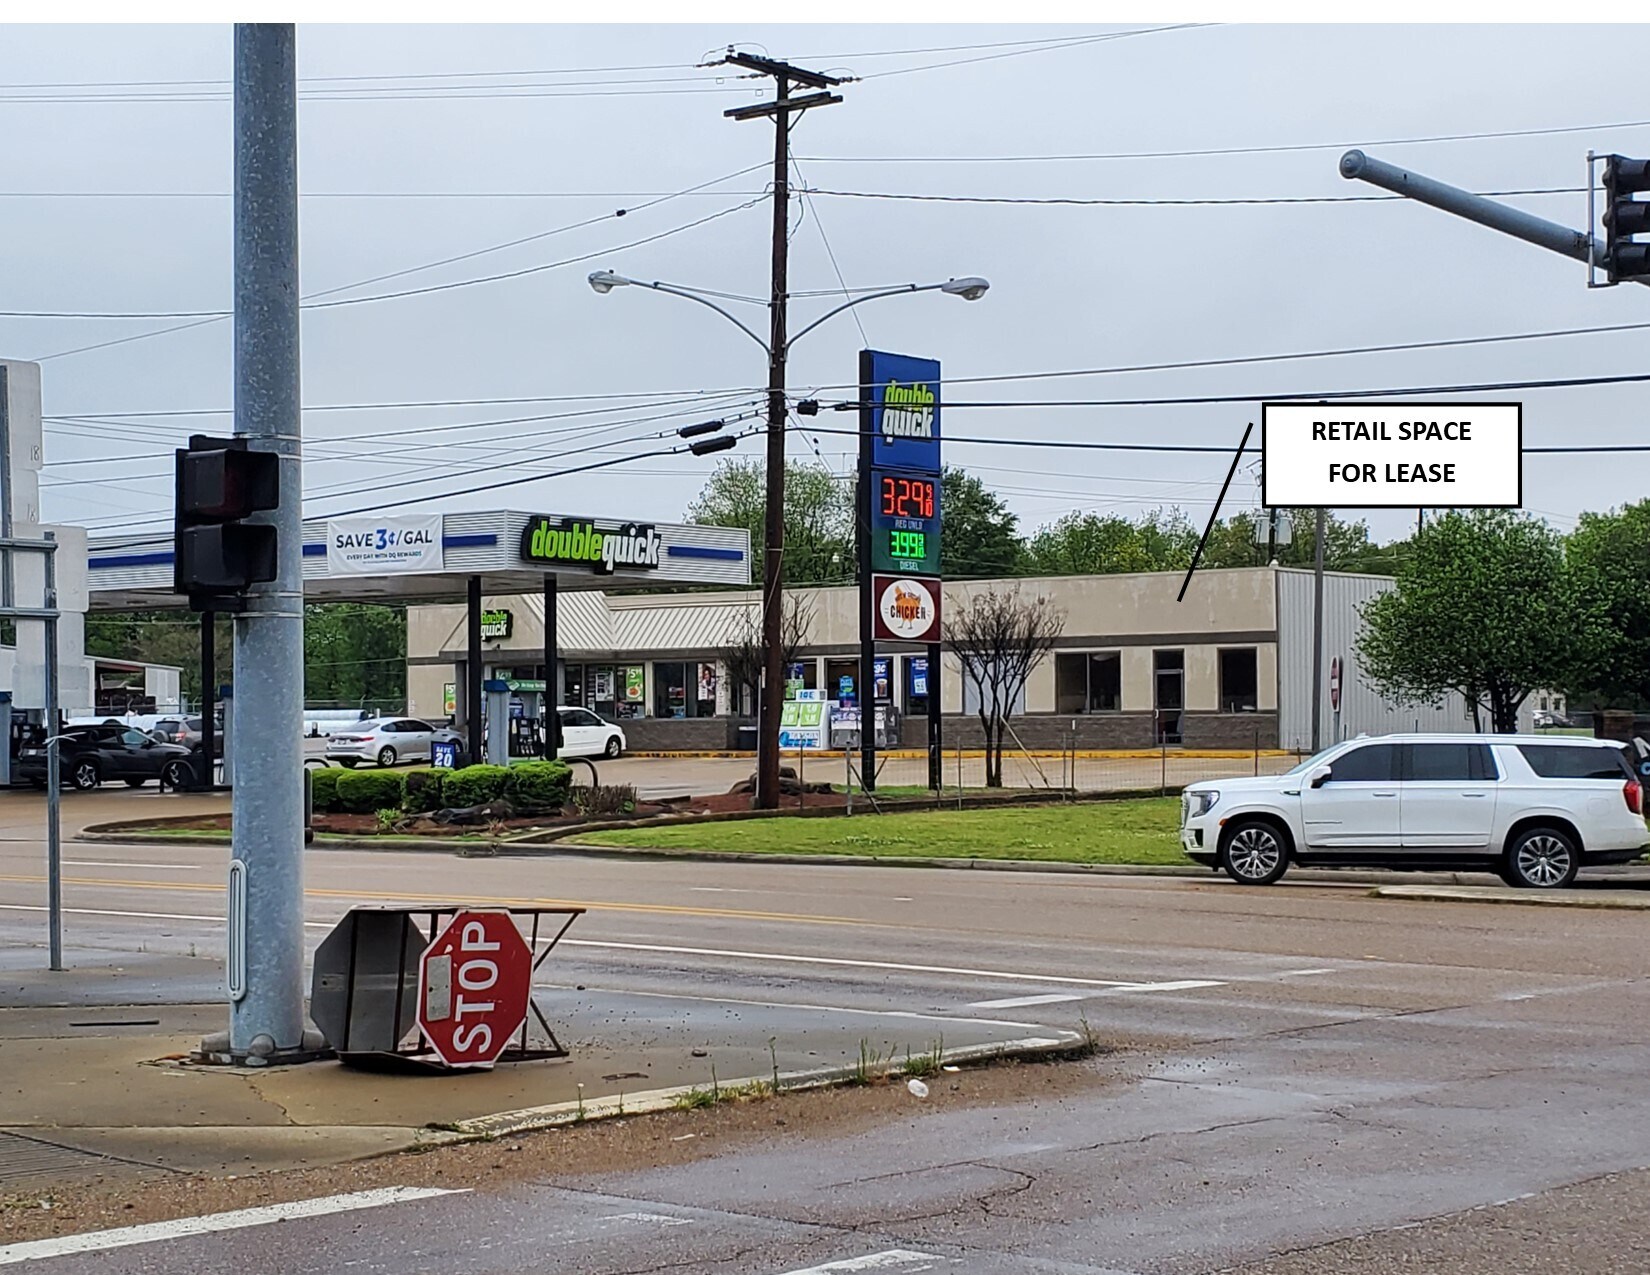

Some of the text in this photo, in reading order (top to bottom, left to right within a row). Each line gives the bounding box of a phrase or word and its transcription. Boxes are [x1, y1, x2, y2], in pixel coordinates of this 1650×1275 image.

[884, 380, 934, 411] double
[882, 407, 933, 443] quick
[336, 533, 373, 549] SAVE
[481, 620, 508, 641] quick
[435, 753, 453, 766] 20
[453, 921, 501, 1054] STOP
